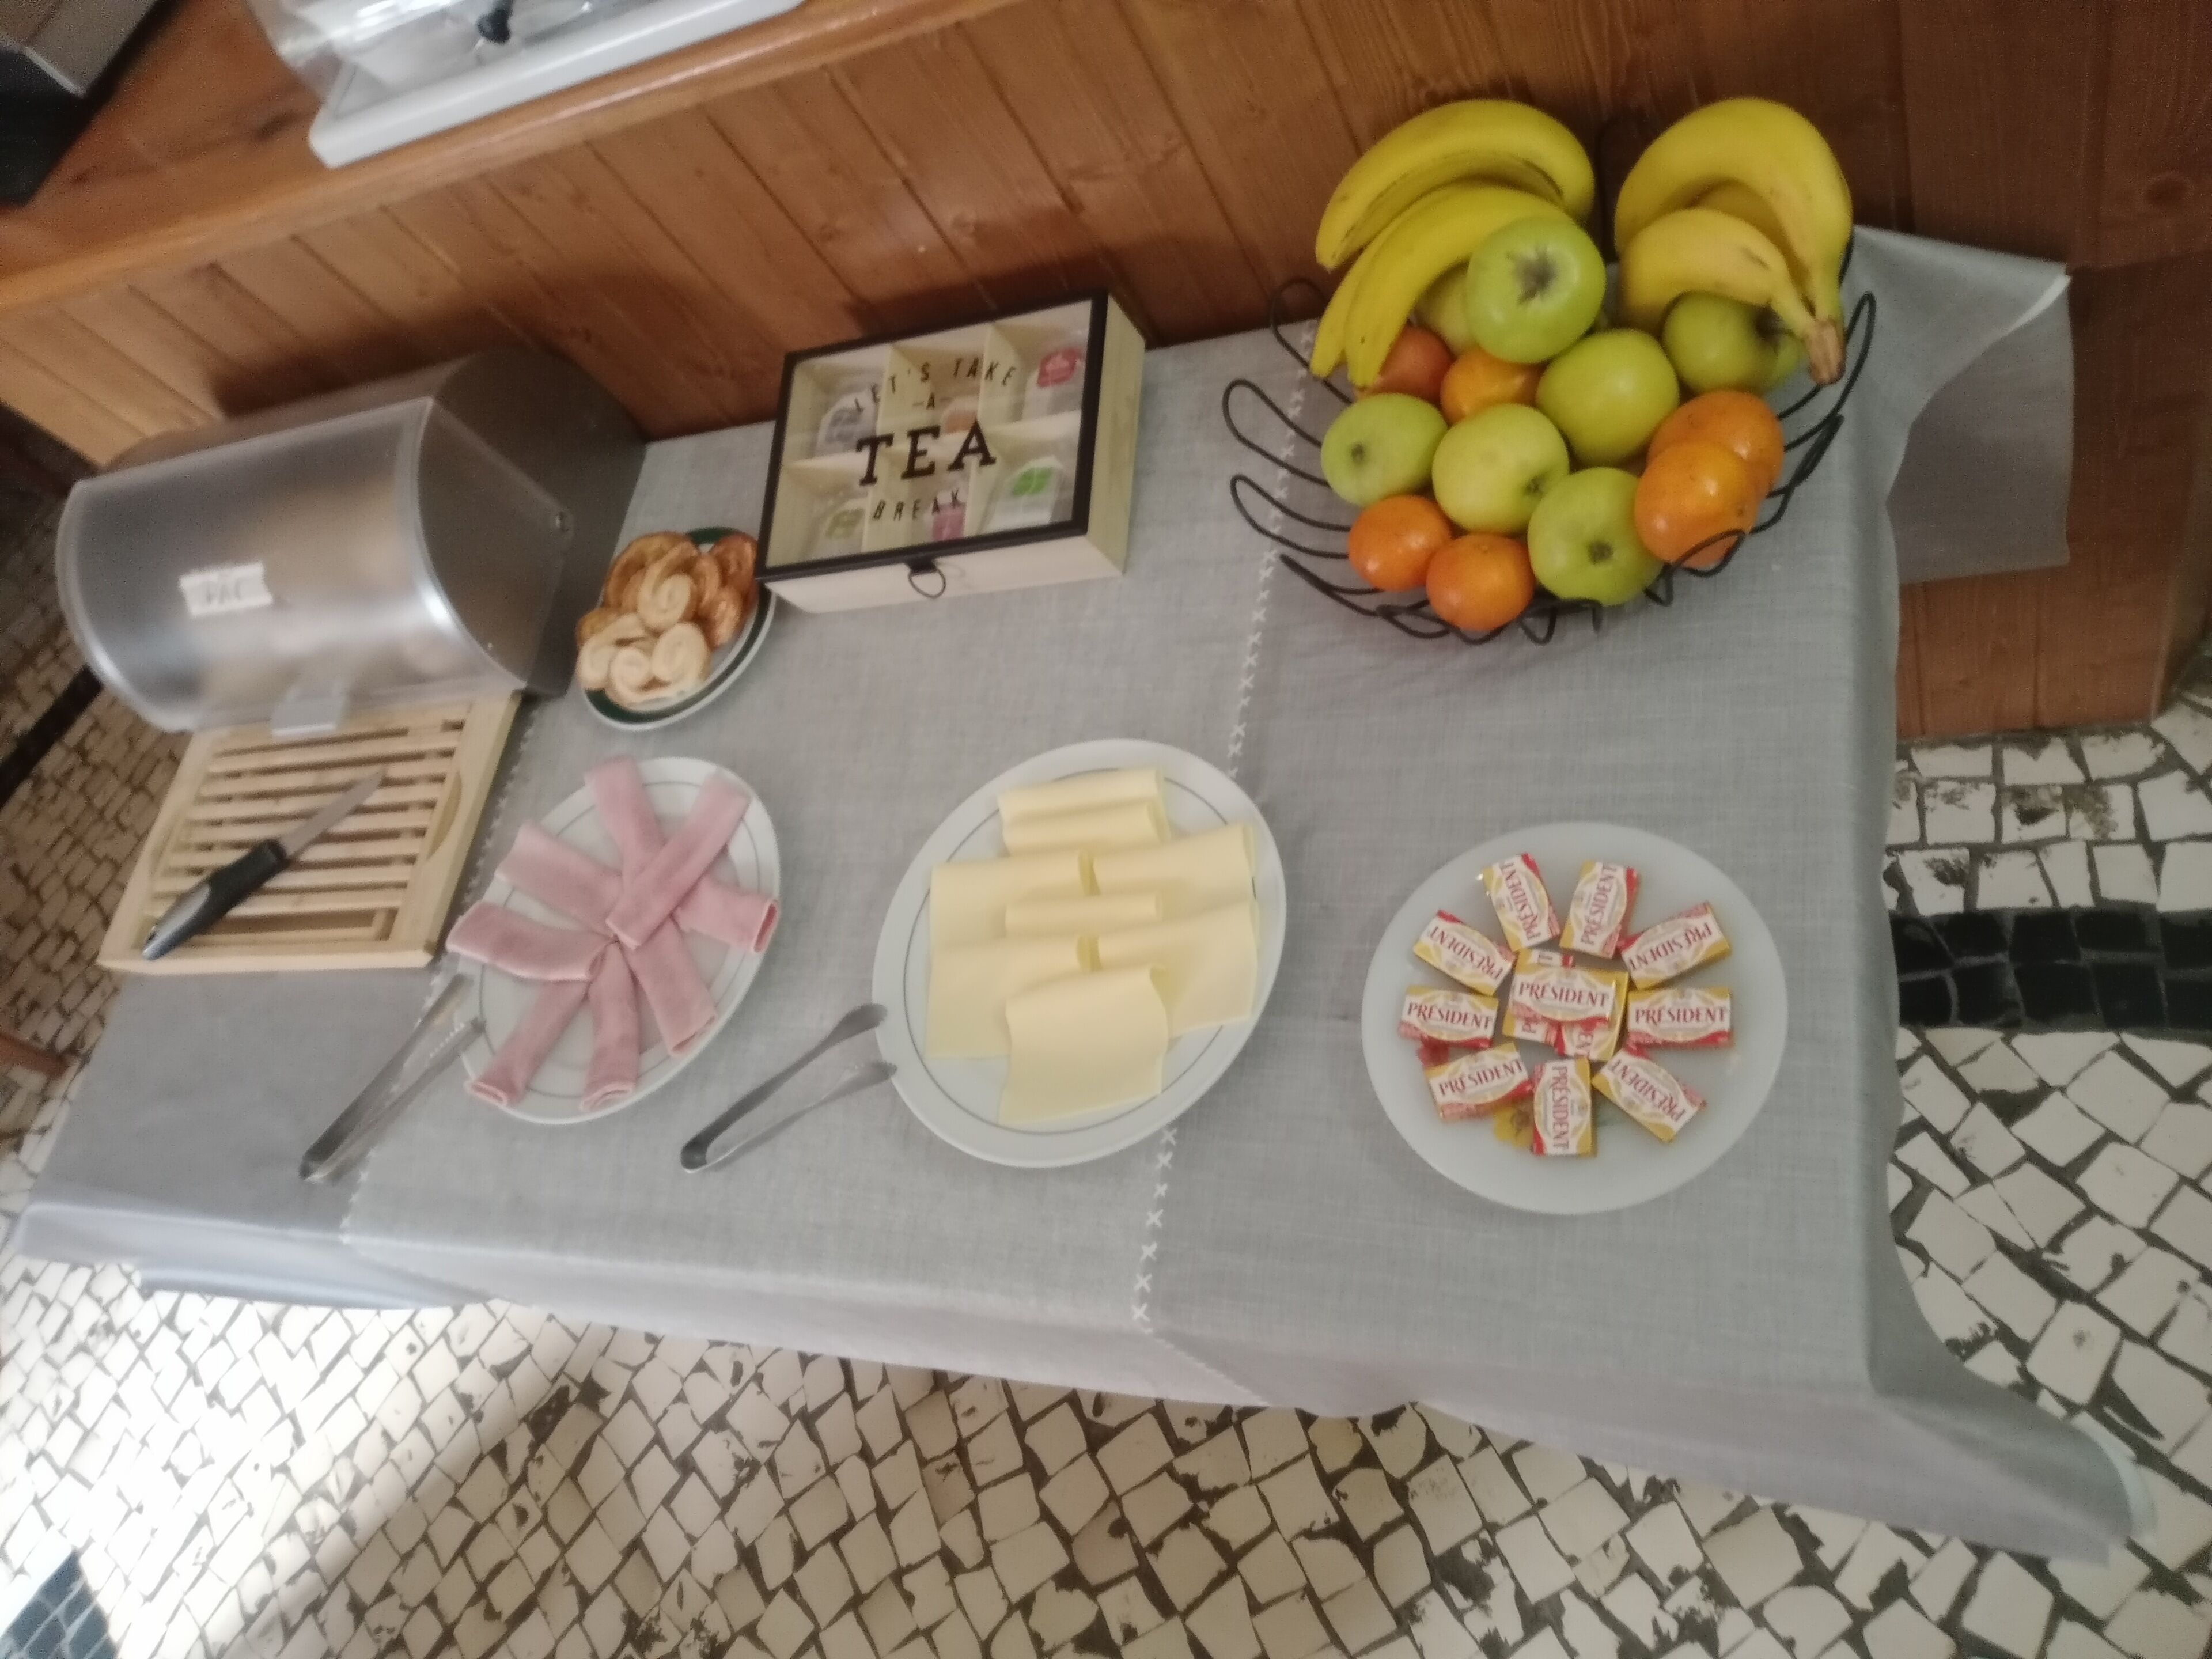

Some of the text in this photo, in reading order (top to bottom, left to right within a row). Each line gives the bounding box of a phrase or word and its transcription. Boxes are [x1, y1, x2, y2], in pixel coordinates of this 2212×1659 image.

[855, 357, 1017, 413] LET'S TAKE
[926, 392, 937, 411] A
[855, 421, 997, 487] TEA
[873, 488, 961, 520] BREAK
